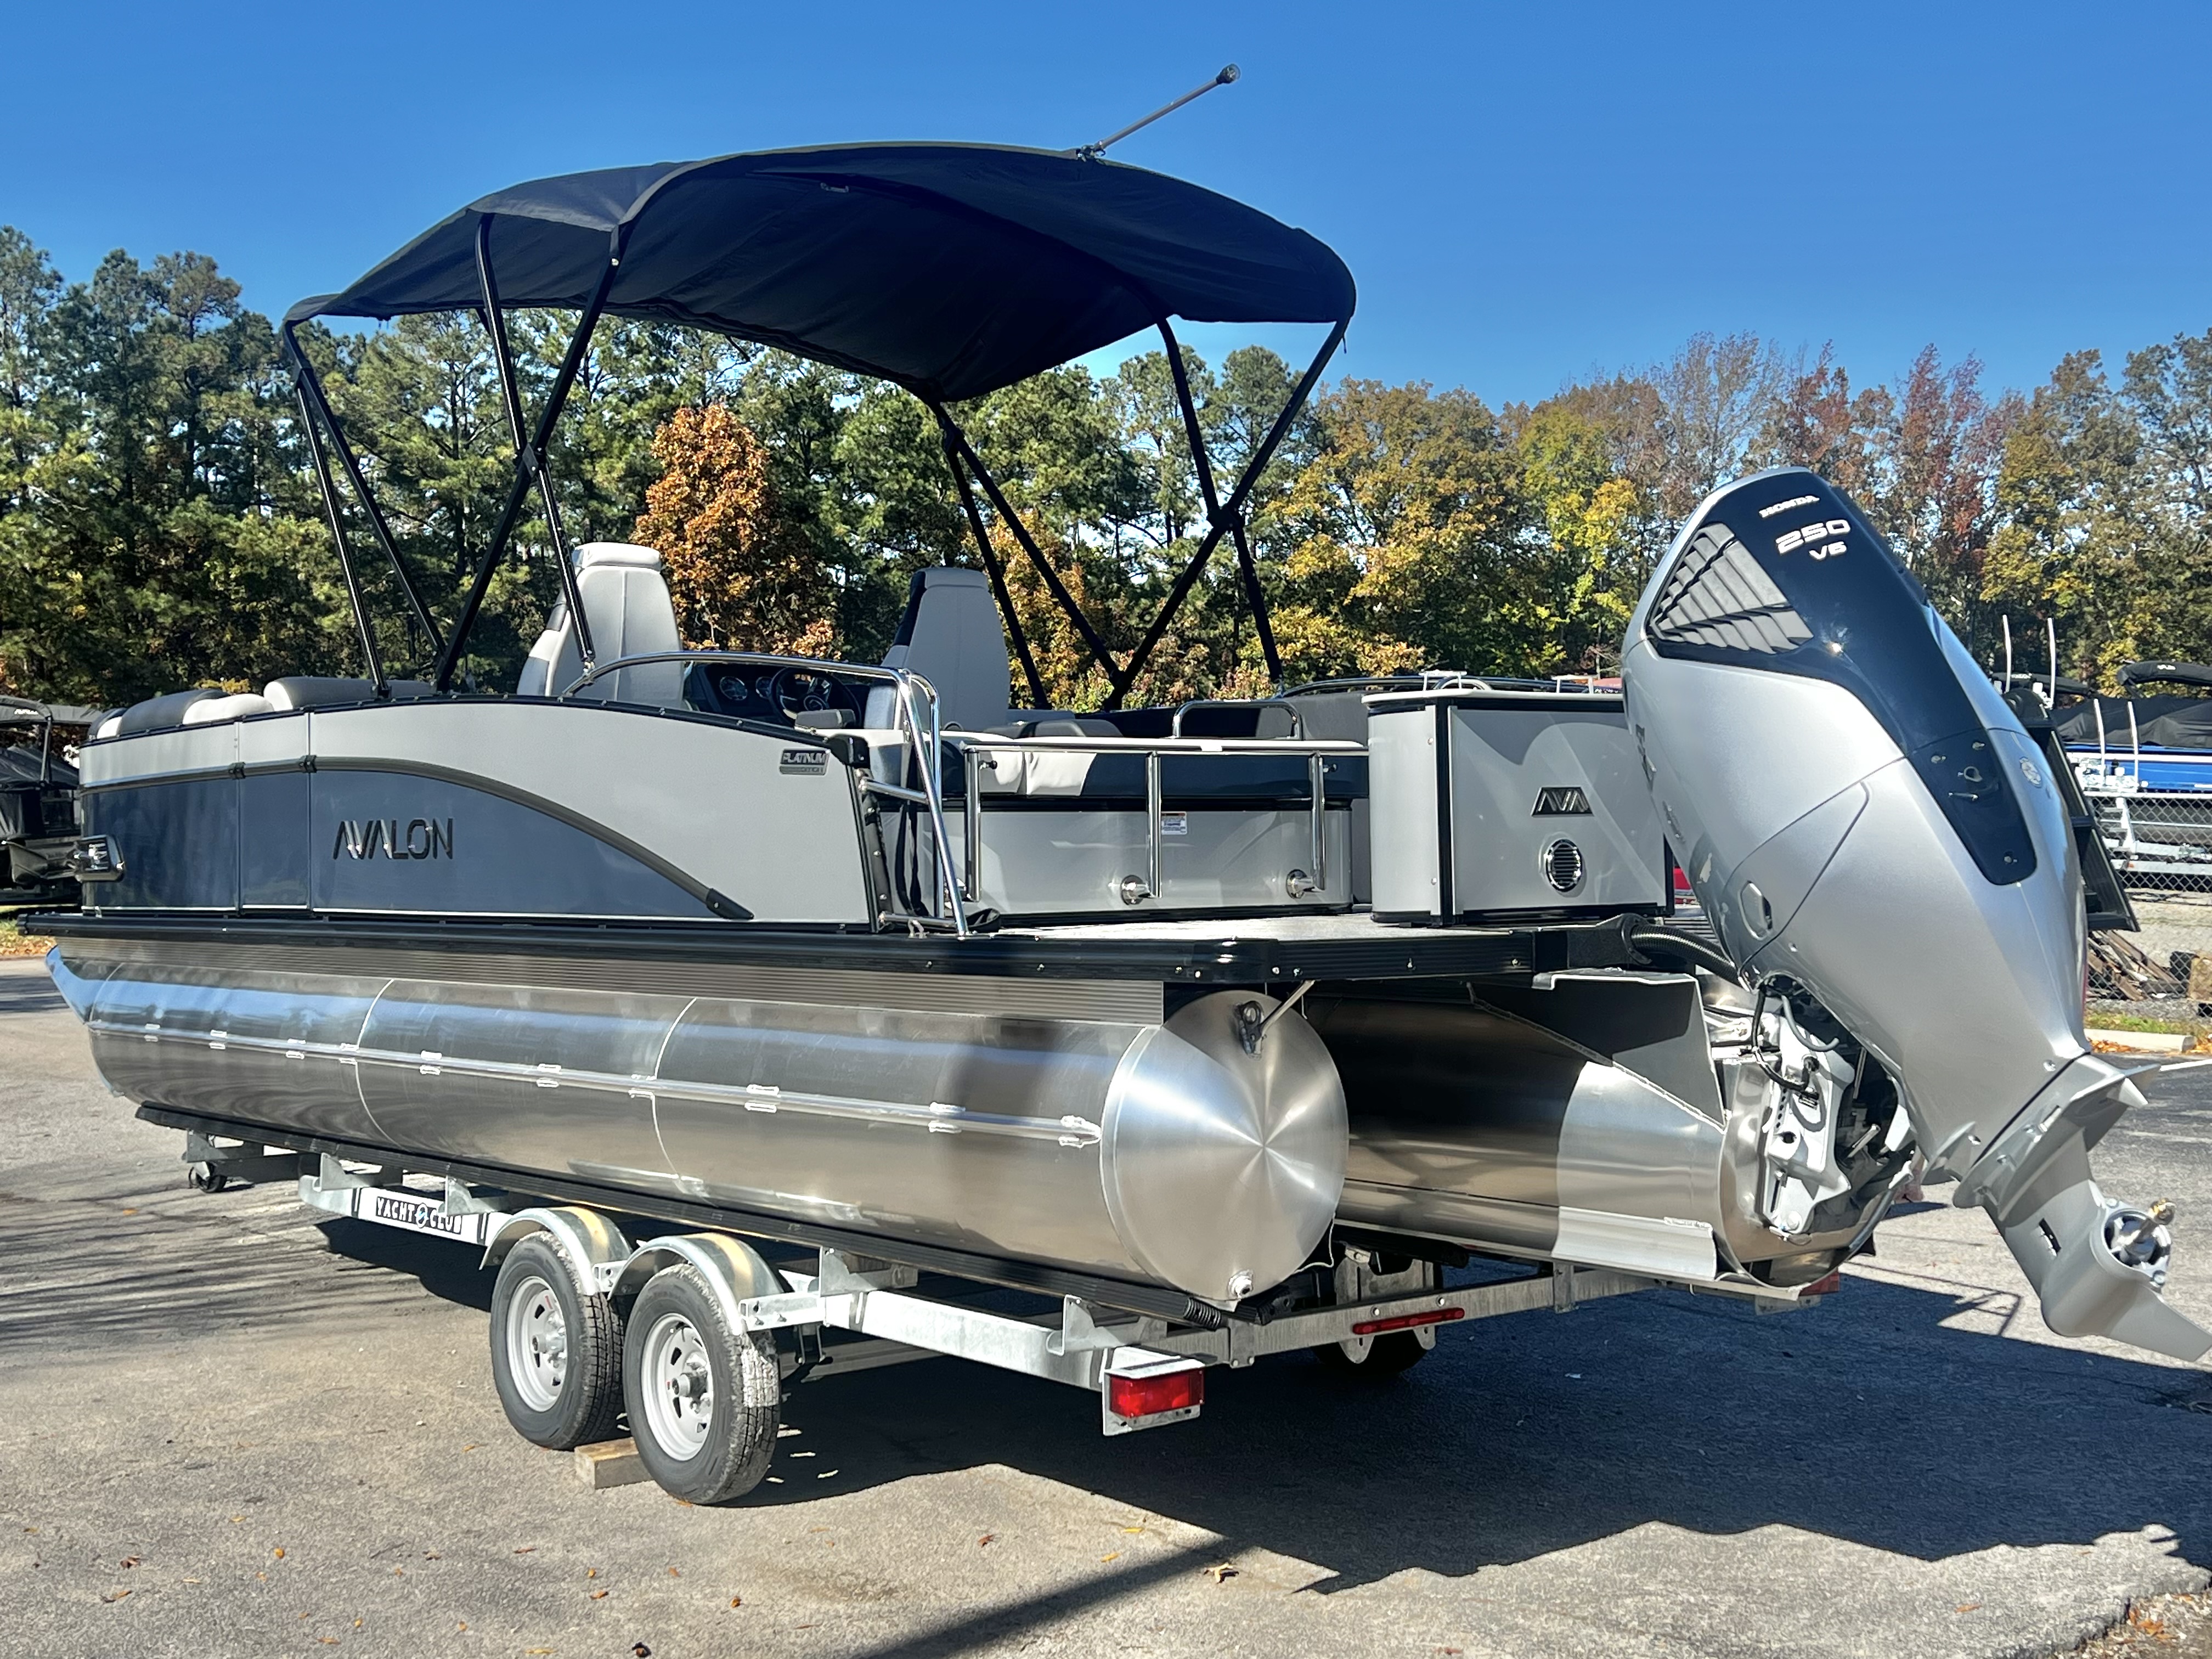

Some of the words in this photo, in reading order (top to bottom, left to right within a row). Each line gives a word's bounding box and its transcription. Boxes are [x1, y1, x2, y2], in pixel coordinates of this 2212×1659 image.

[1775, 519, 1851, 555] 250
[1808, 541, 1847, 560] V6
[782, 752, 827, 764] PLATINUM
[332, 817, 453, 860] AVALON
[377, 1197, 415, 1223] YACHT
[429, 1209, 462, 1234] CLUB
